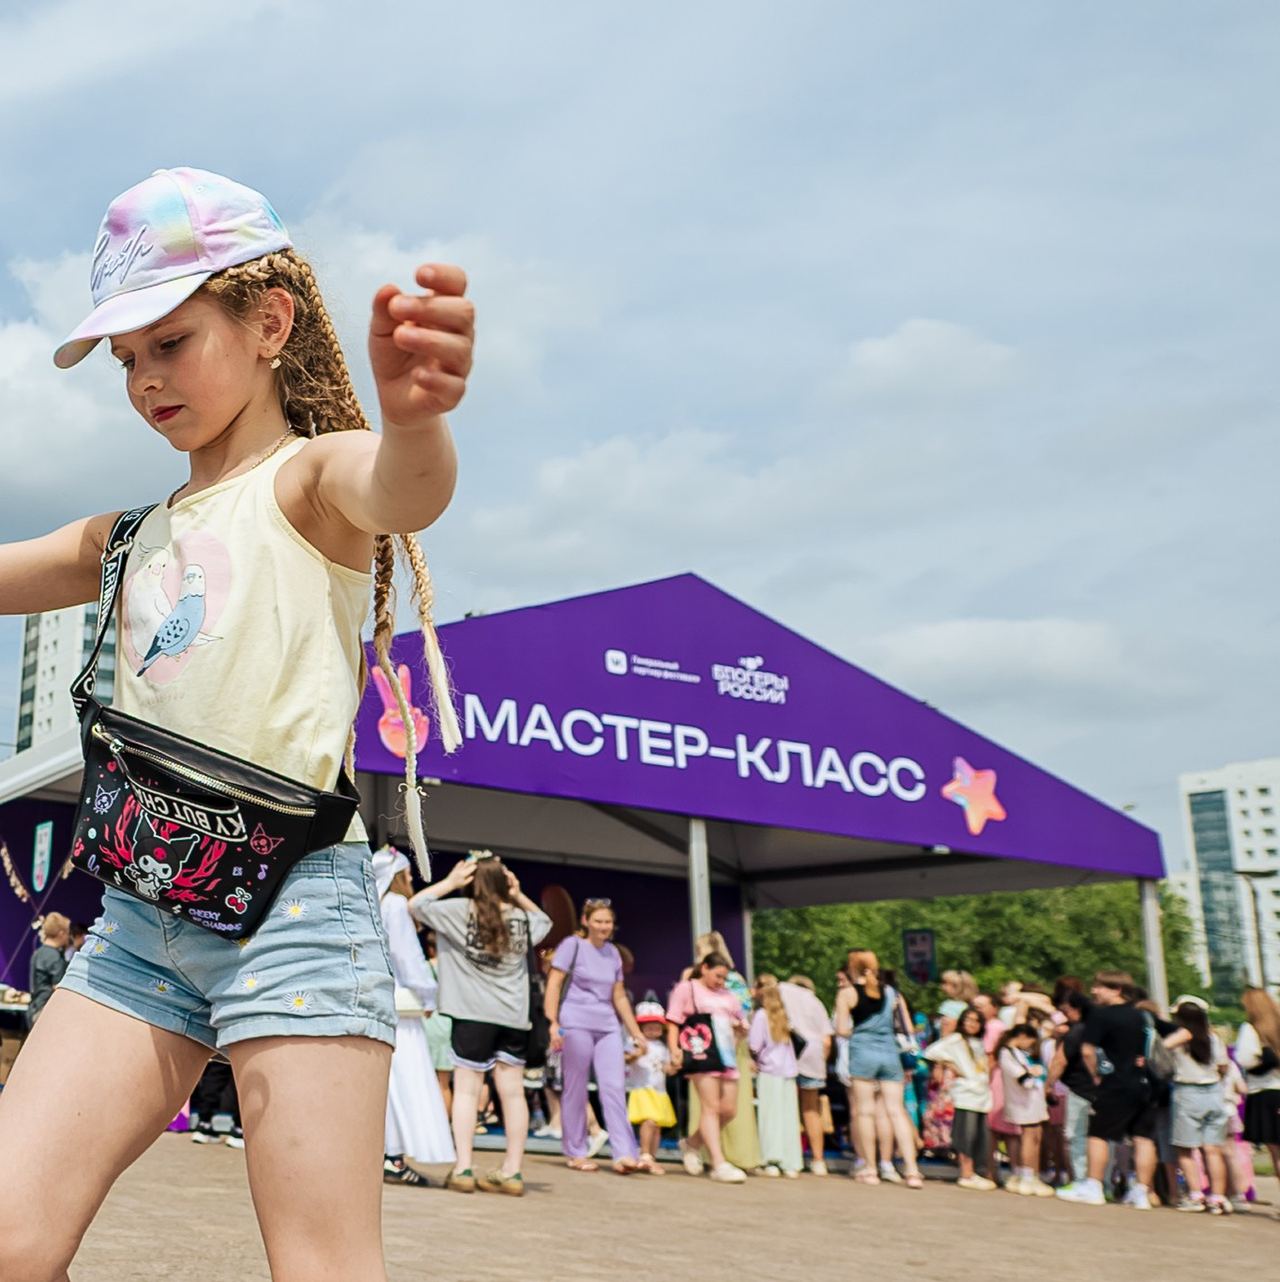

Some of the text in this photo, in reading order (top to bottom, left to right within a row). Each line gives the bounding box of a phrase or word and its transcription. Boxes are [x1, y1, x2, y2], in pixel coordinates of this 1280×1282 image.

[712, 664, 789, 691] БЛОГЕРЫ
[718, 679, 786, 704] РОССИИ
[464, 693, 927, 802] МАСТЕР-КЛАСС
[172, 801, 212, 831] BUT
[188, 908, 221, 921] CHEEKY
